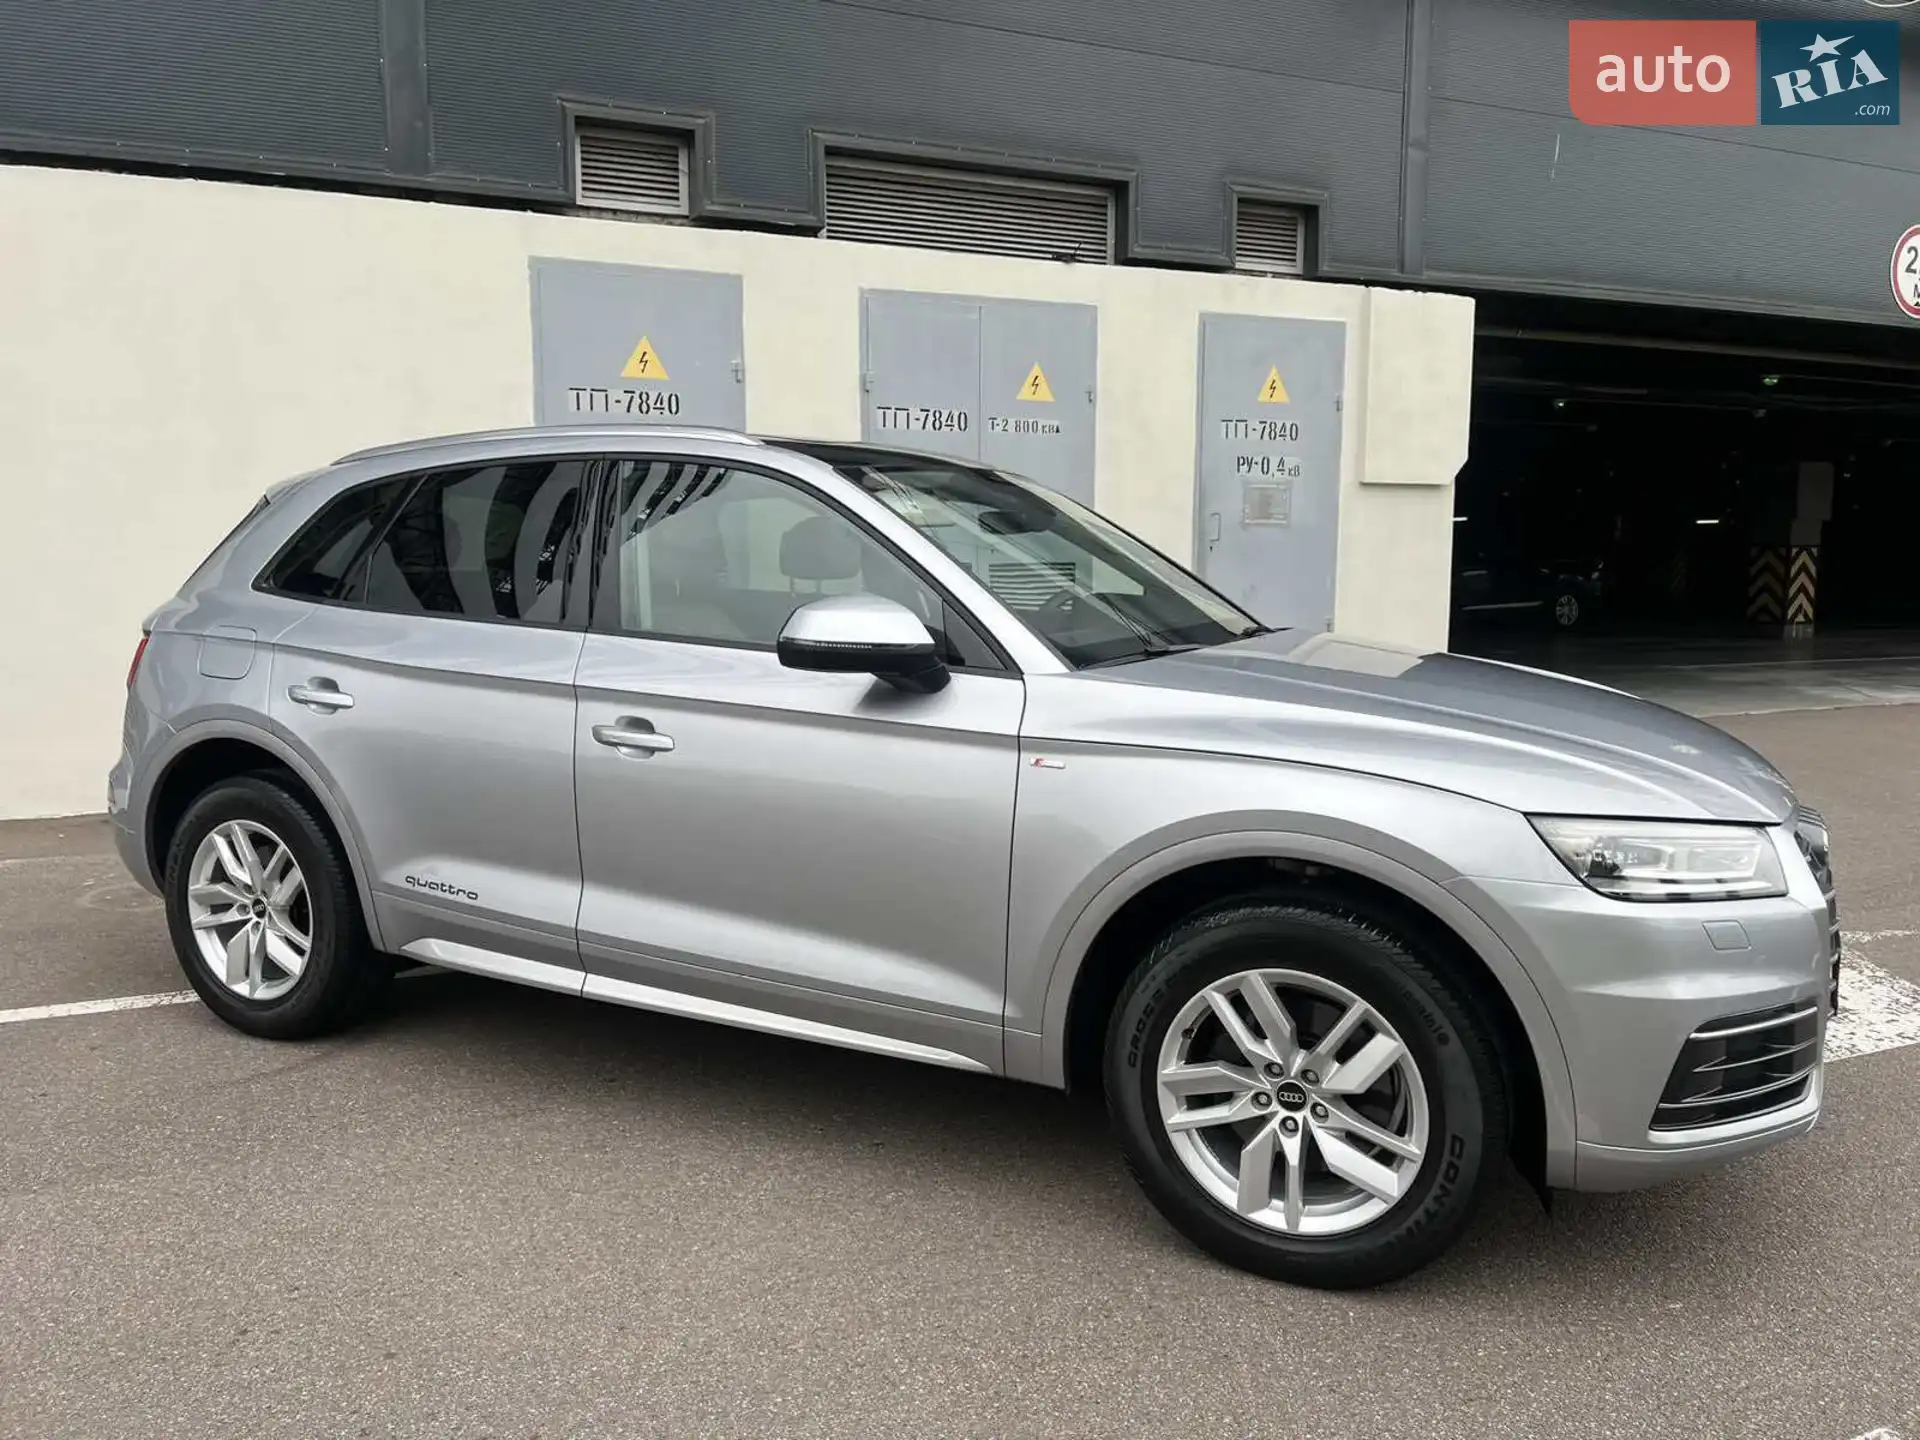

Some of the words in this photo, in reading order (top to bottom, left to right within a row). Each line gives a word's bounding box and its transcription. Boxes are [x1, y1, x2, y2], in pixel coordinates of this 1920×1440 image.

[568, 387, 680, 415] ТП-7840
[876, 405, 969, 432] ТП-7840
[1221, 419, 1299, 441] ТП-7840
[404, 874, 479, 901] quattro
